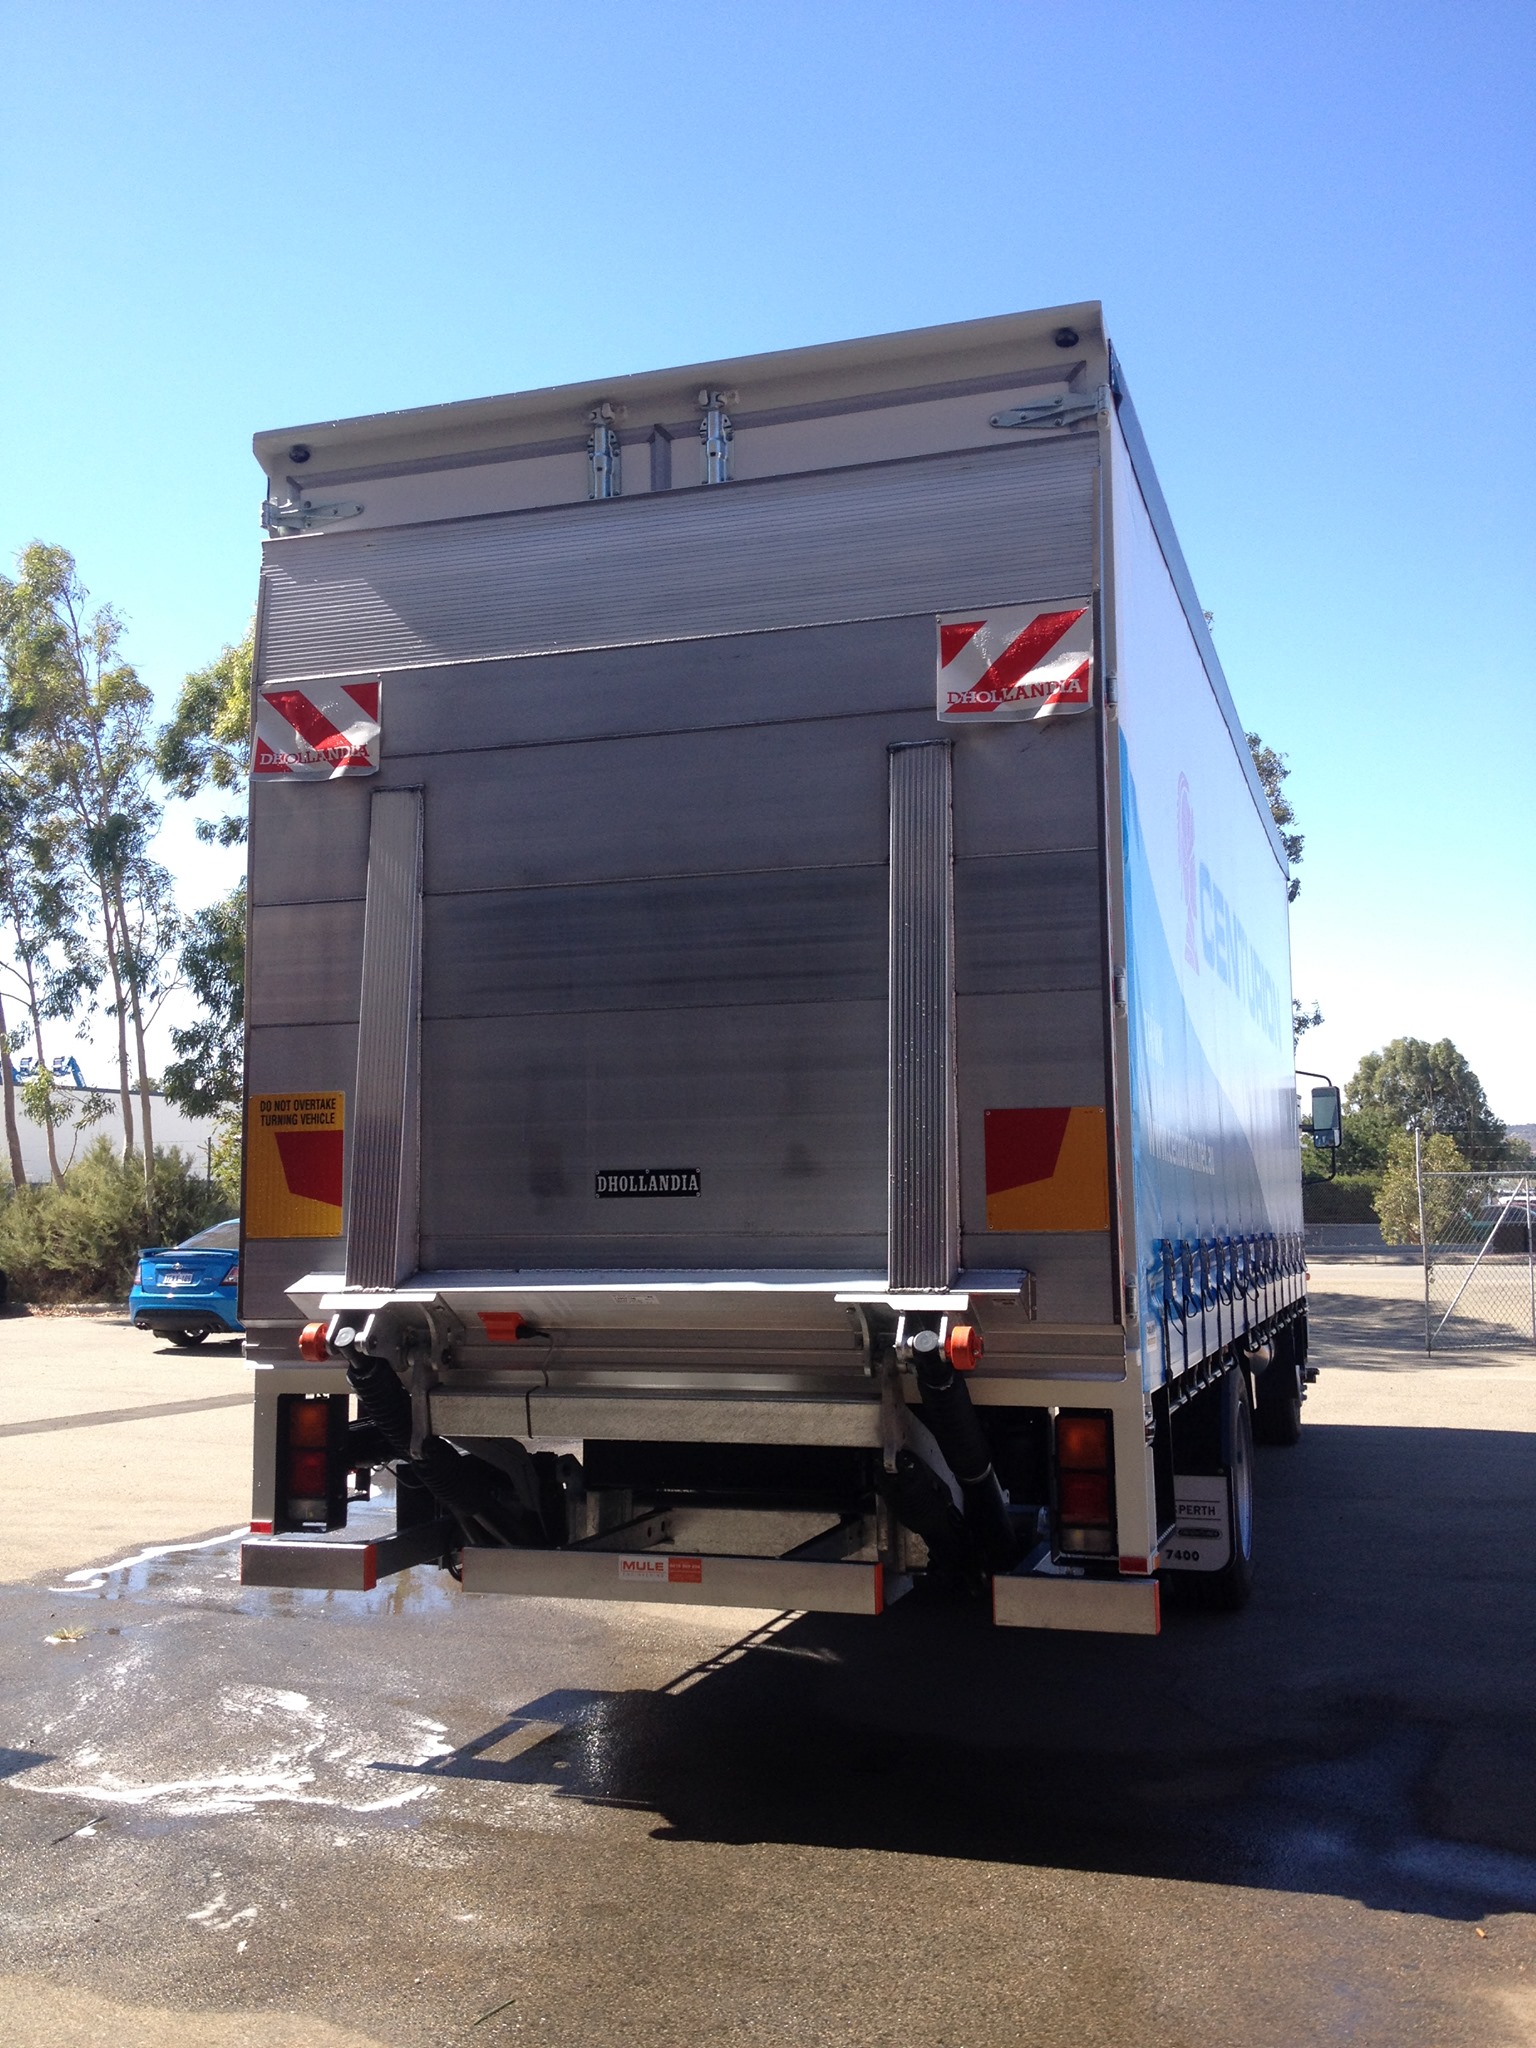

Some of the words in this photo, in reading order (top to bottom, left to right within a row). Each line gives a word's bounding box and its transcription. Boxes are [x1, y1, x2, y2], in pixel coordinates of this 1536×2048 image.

[946, 678, 1083, 705] DHOLLANDIA
[259, 744, 370, 766] DHOLLANDIA
[1199, 862, 1282, 1052] CENTURION
[260, 1100, 272, 1112] DO
[274, 1099, 291, 1112] NOT
[293, 1098, 336, 1112] OVERTAKE
[260, 1114, 298, 1127] TURNING
[300, 1112, 335, 1125] VEHICLE
[597, 1174, 699, 1193] DHOLLANDIA
[1178, 1504, 1216, 1516] PERTH
[1165, 1549, 1200, 1562] 7400
[622, 1560, 664, 1572] MULE
